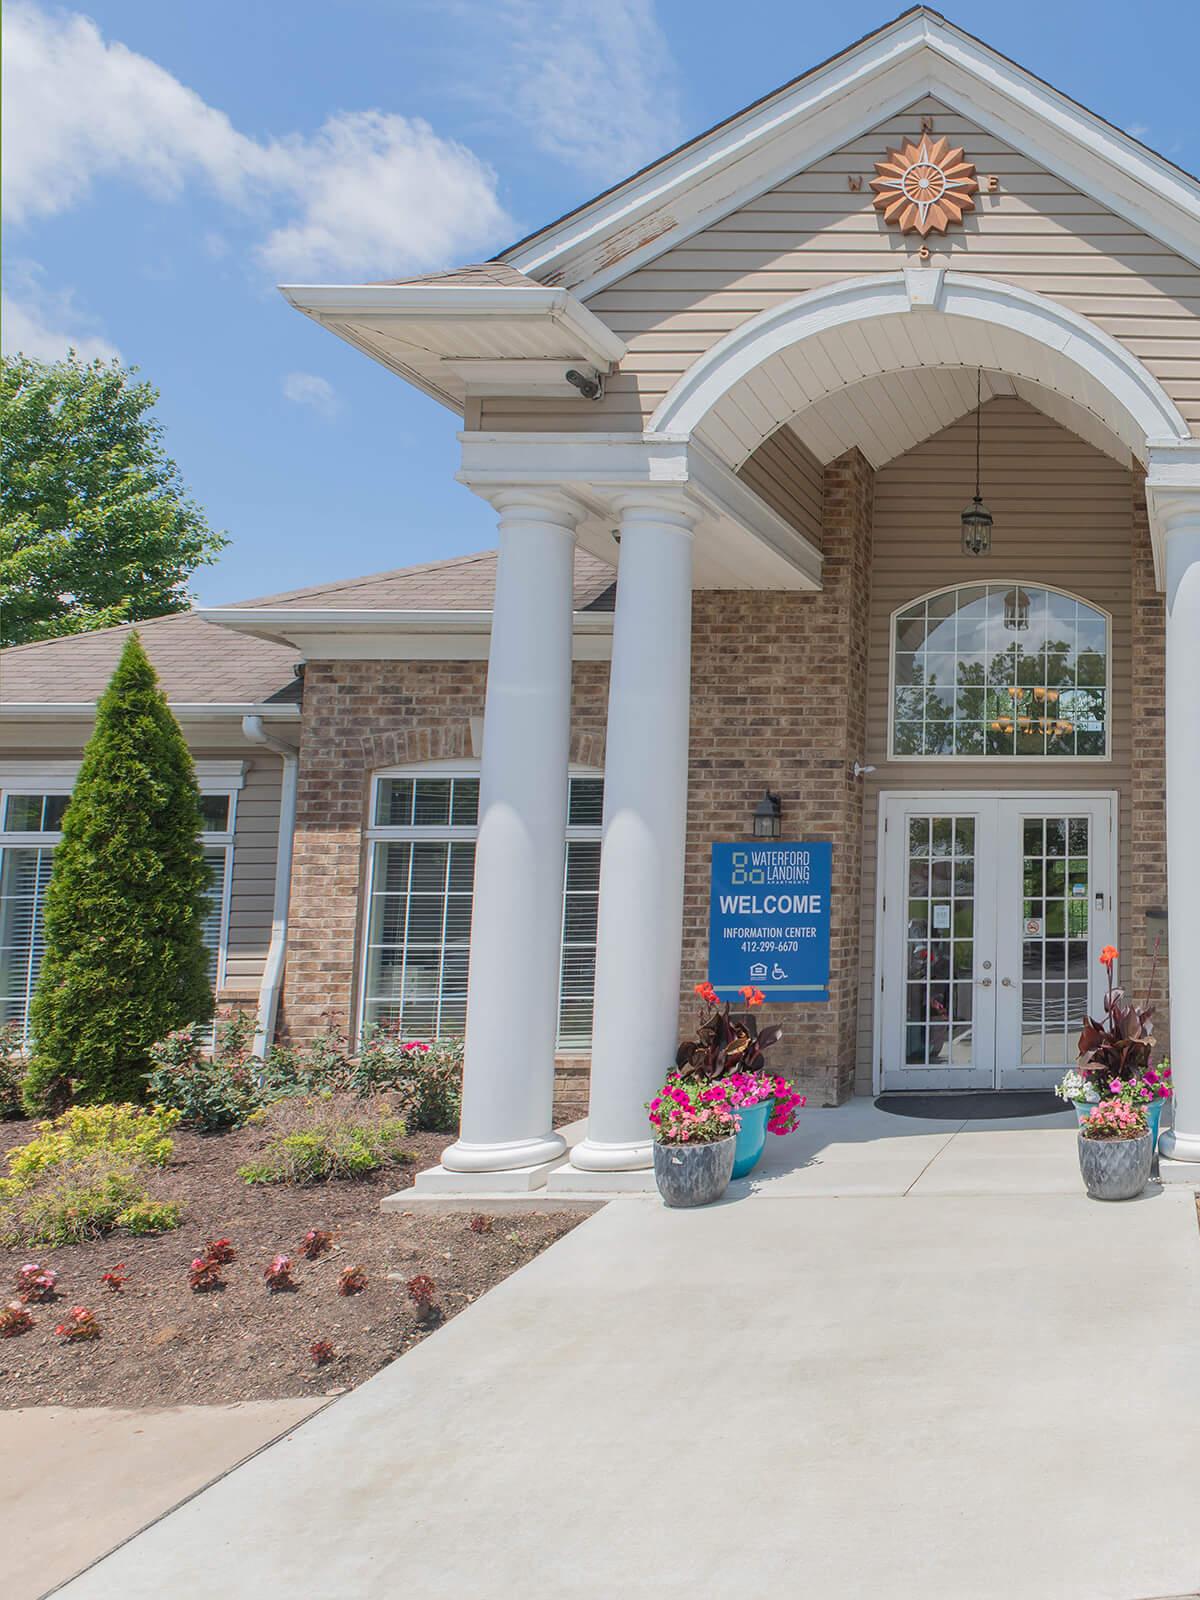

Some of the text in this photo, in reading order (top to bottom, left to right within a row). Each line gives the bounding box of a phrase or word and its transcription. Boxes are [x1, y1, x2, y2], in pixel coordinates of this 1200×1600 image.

[848, 176, 863, 191] W
[988, 175, 999, 191] E
[918, 245, 930, 259] S
[751, 851, 810, 866] WATERFORD
[767, 866, 810, 881] LANDING
[719, 895, 822, 914] WELCOME
[723, 927, 817, 939] INFORMATION CENTER
[741, 941, 799, 952] 412-299-6670
